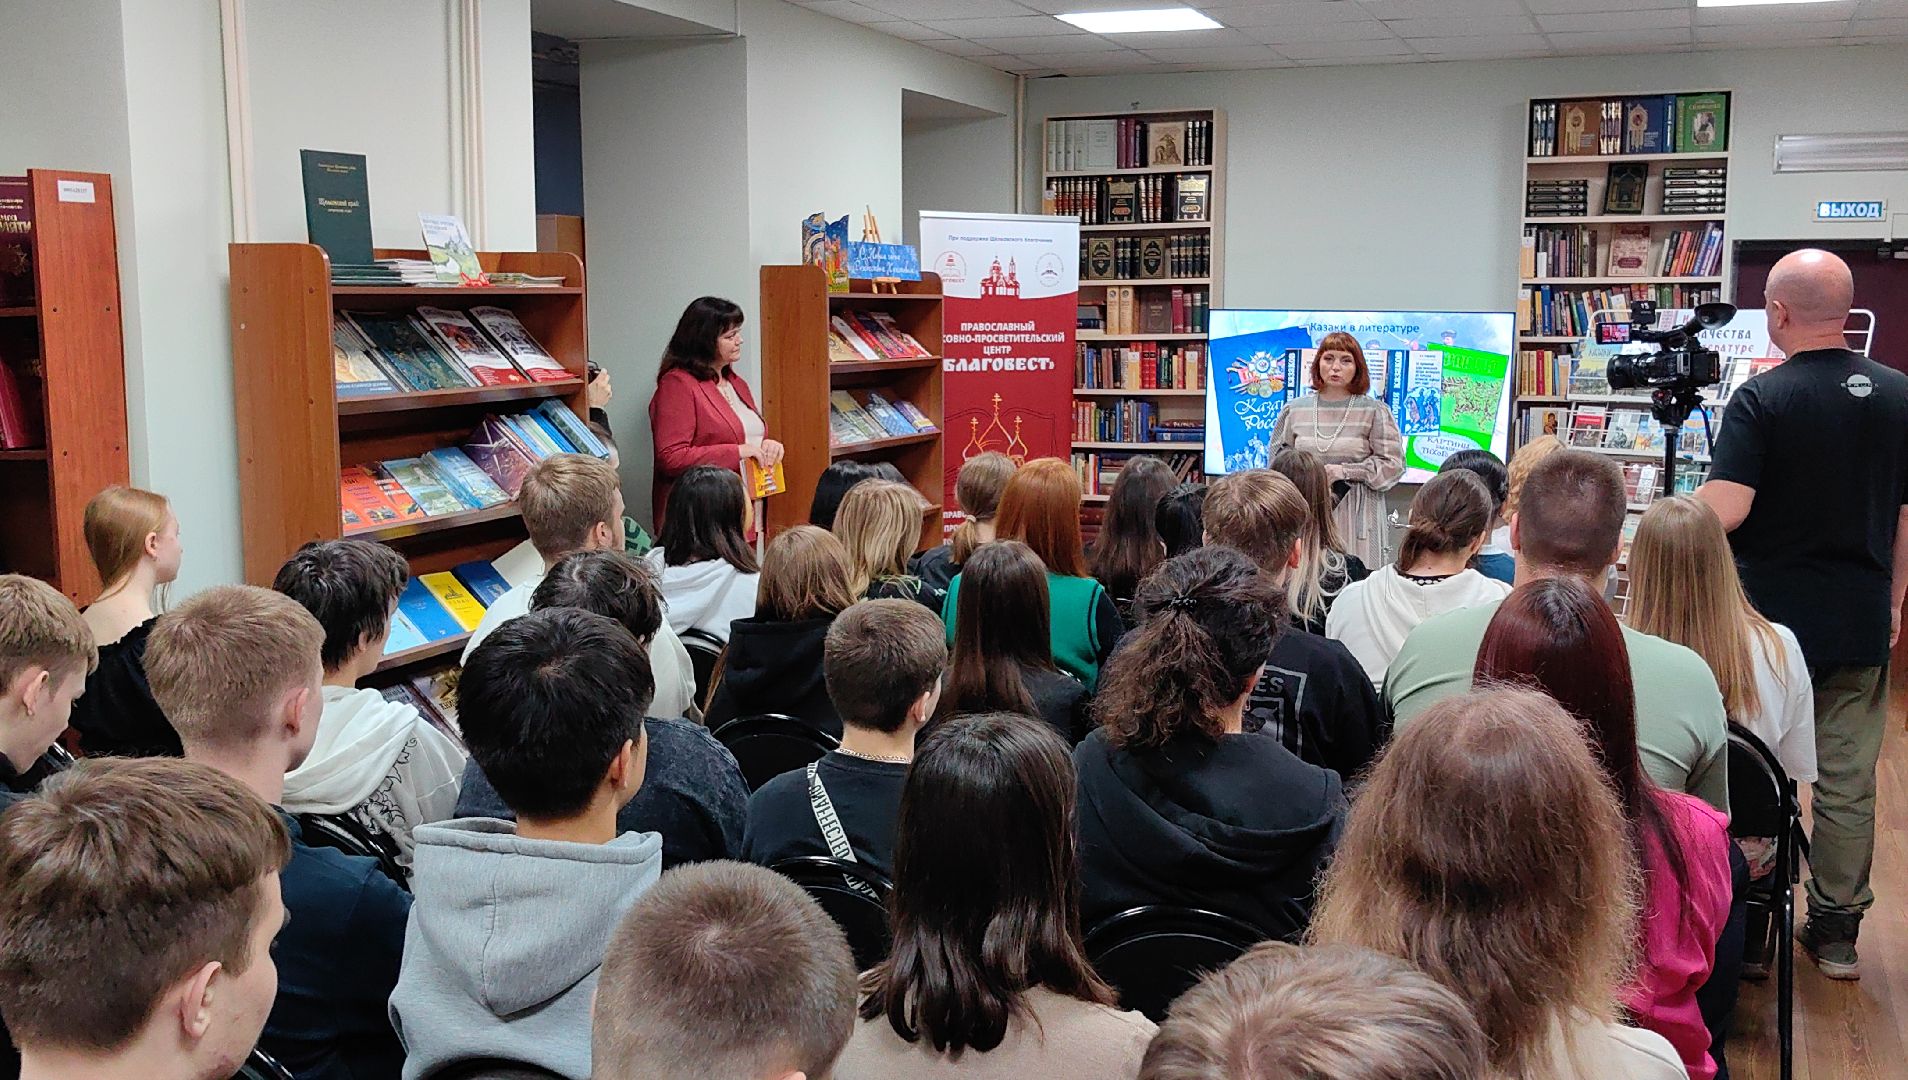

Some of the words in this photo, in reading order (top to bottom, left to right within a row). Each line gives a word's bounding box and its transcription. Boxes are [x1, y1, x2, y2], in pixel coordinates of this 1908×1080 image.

[1819, 203, 1879, 217] ВЫХОД
[960, 321, 1035, 331] ПРАВОСЛАВНЫЙ
[1310, 322, 1346, 332] Казаки
[1358, 324, 1420, 334] литературе
[1698, 329, 1752, 339] АЧЕСТВА
[983, 346, 1012, 355] ЦЕНТР
[1703, 344, 1754, 355] ЕРАТУРЕ
[943, 358, 1055, 371] БЛАГОВЕСТ»
[1234, 398, 1284, 418] Каза
[1240, 415, 1278, 431] Росс
